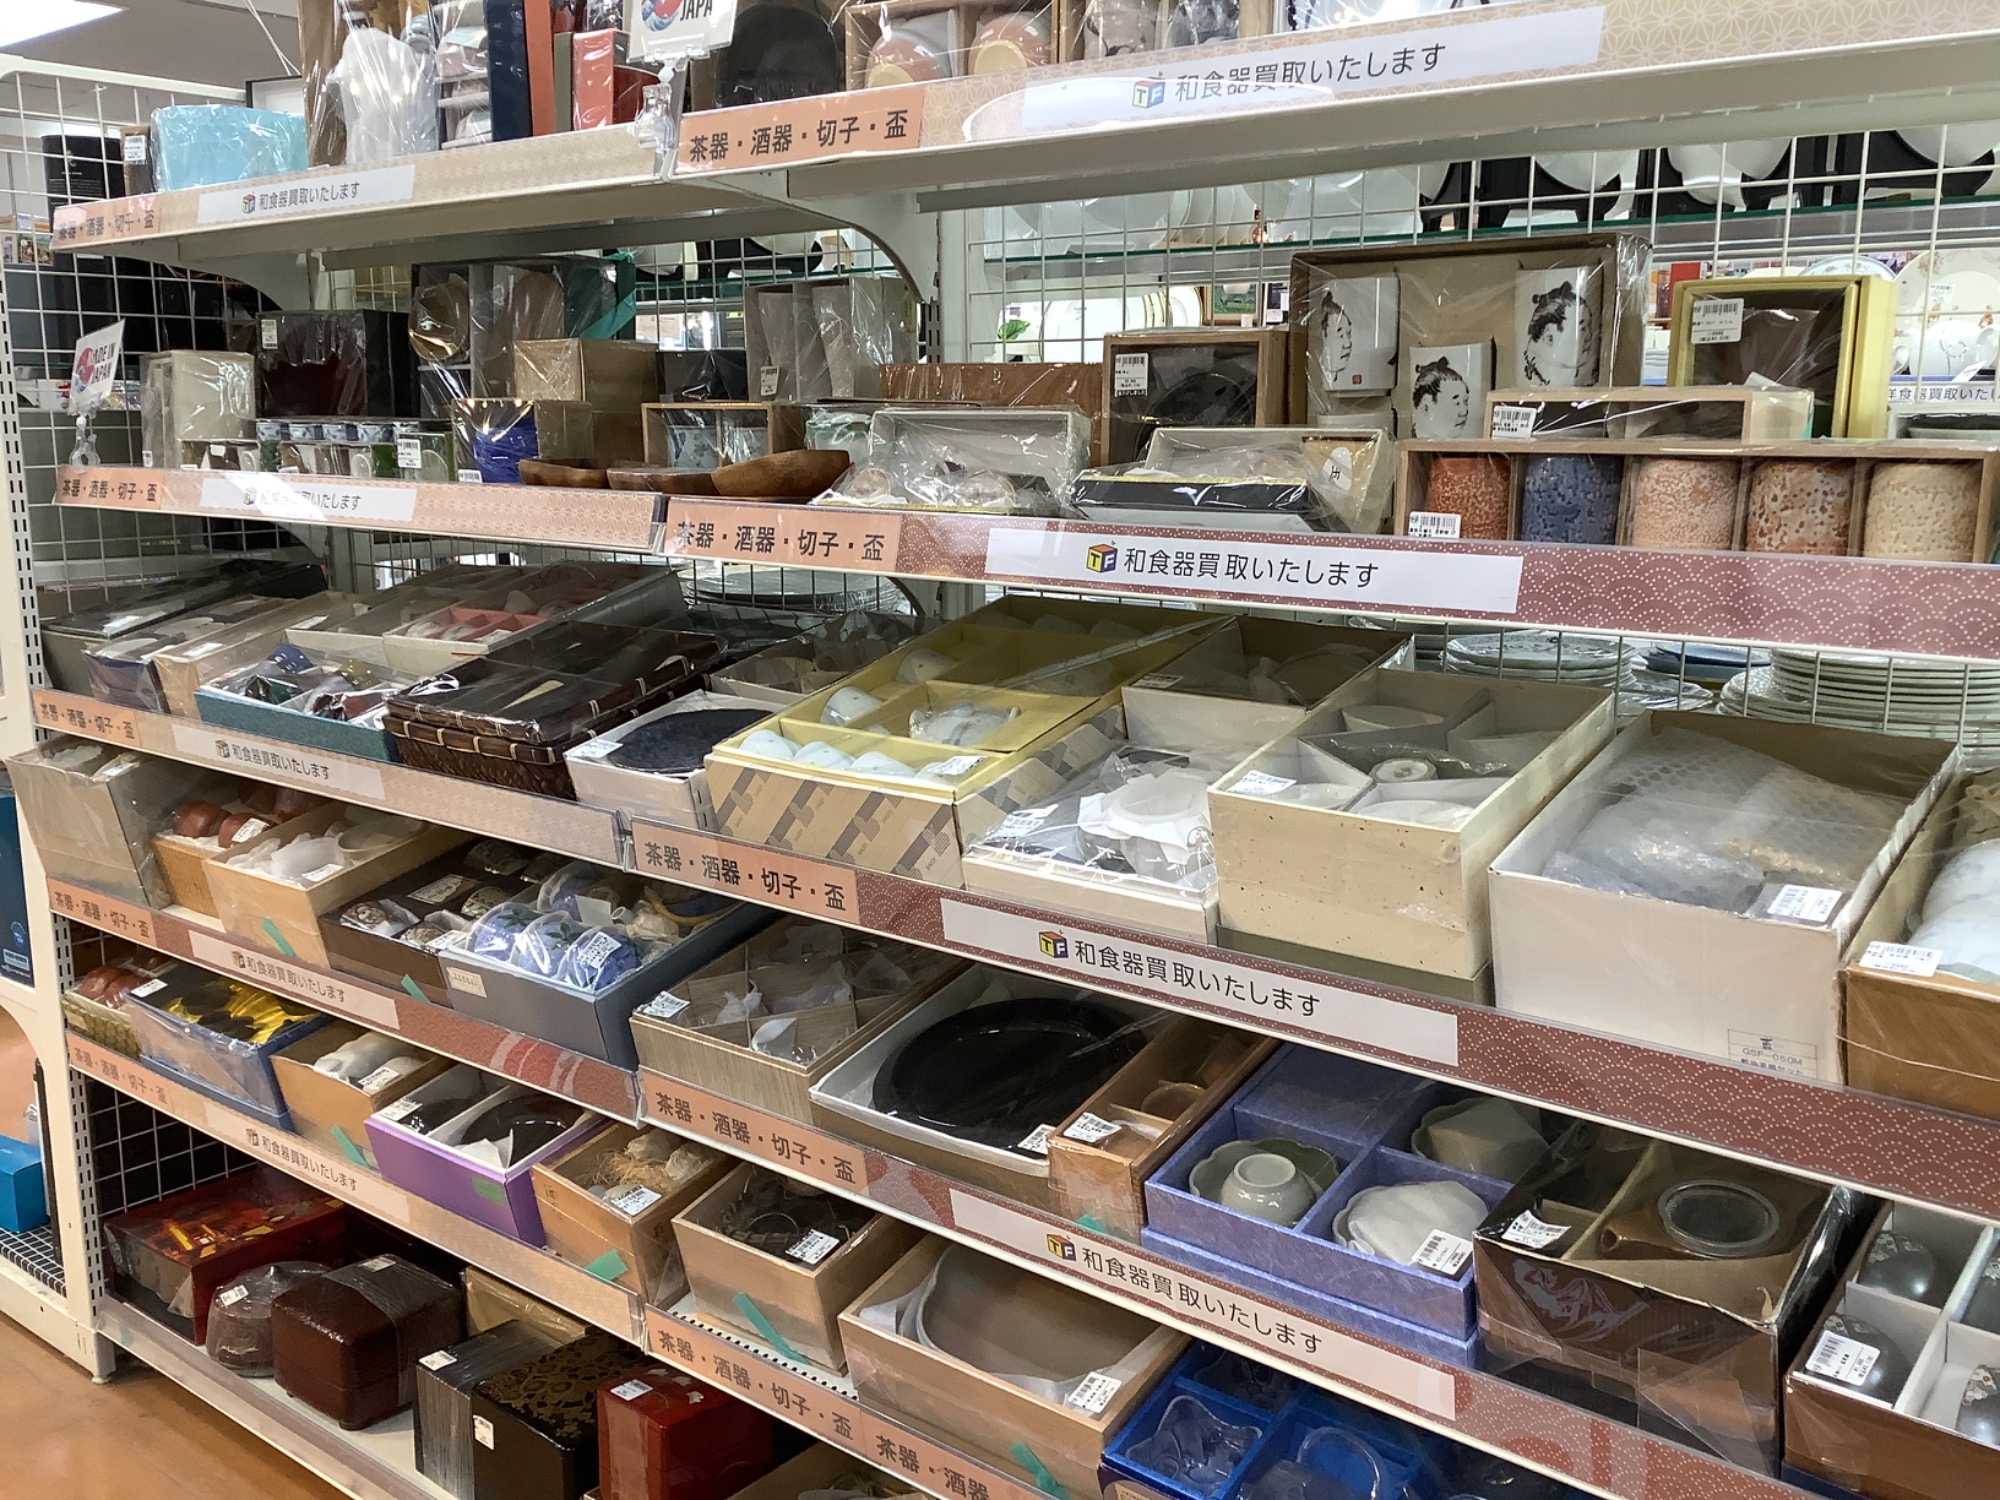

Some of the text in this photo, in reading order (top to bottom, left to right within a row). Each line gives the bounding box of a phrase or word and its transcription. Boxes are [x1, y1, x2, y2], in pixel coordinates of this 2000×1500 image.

[680, 0, 714, 21] JAPA
[1175, 42, 1446, 102] 和食器買取いたします
[689, 110, 908, 162] 茶器・酒器・切子・盃
[259, 181, 361, 209] 和食器買取いたします
[62, 479, 158, 502] 茶器・酒器・切子・盃
[260, 489, 361, 511] 取いたします
[677, 522, 885, 561] 茶器・酒器・切子・盃
[1124, 547, 1379, 588] 和食器買取いたします
[232, 743, 330, 780] 和食器買取いたします
[645, 841, 847, 911] 茶器・酒器・切子・盃
[246, 956, 345, 1003] 和食器買取いたします
[1075, 940, 1320, 1016] 和食器買取いたします
[656, 1091, 856, 1184] 茶器・酒器・切子・盃
[262, 1135, 357, 1191] 和食器買取いたします
[1081, 1247, 1322, 1353] 和食器買取いたします
[658, 1330, 853, 1440] 茶器・酒器・切子・盃
